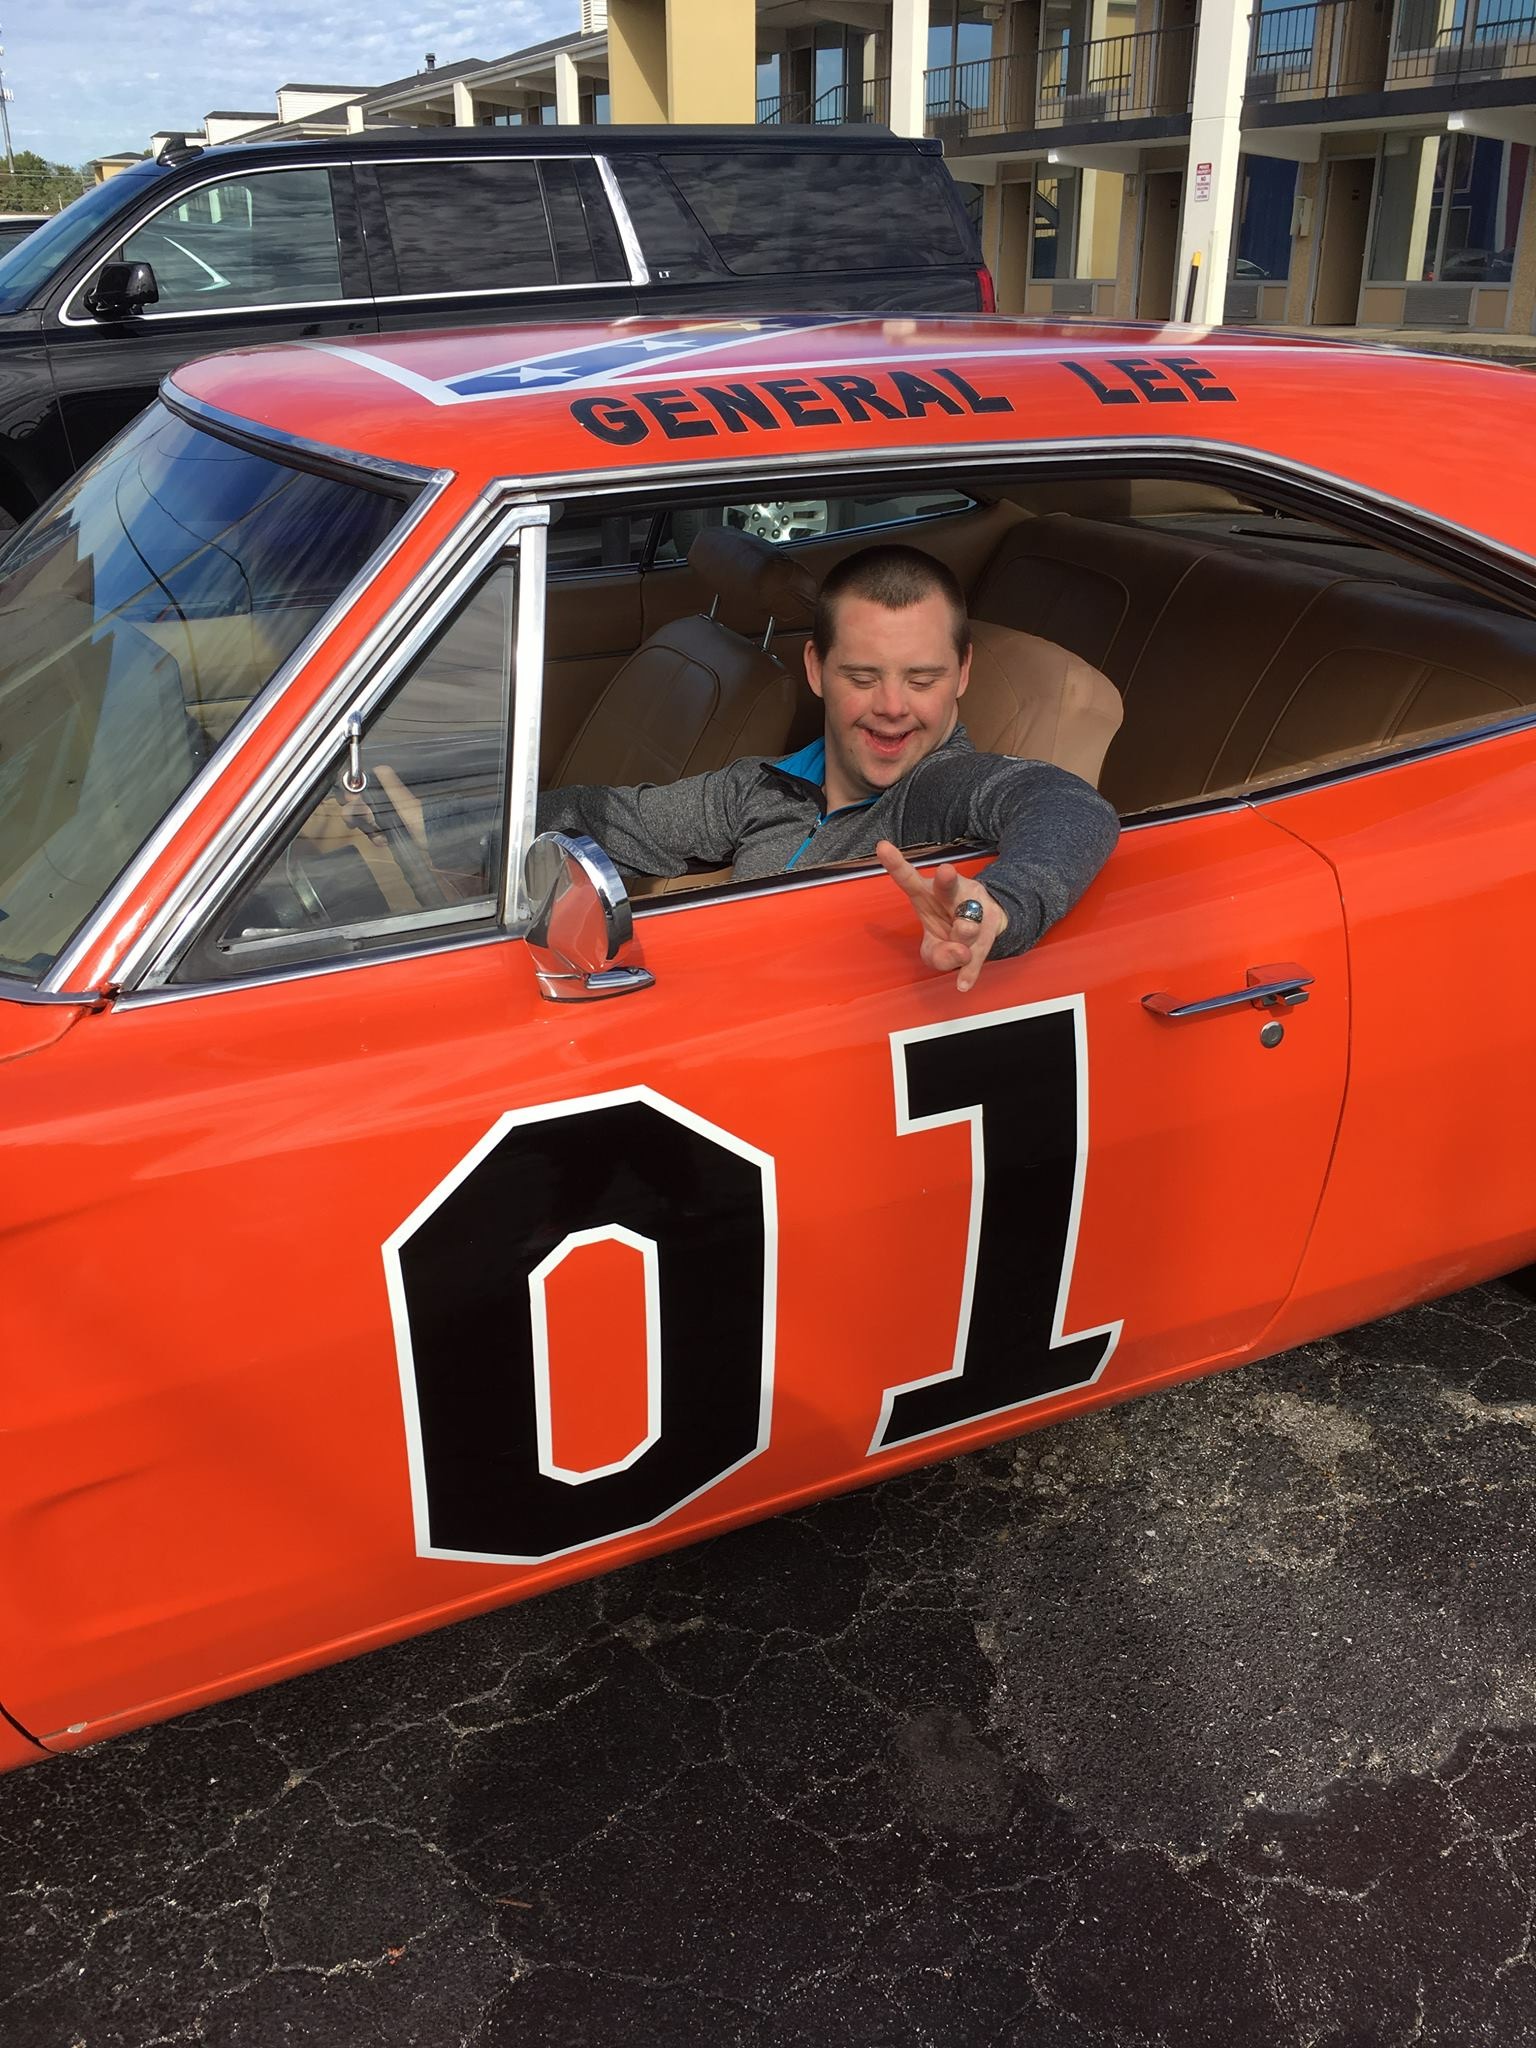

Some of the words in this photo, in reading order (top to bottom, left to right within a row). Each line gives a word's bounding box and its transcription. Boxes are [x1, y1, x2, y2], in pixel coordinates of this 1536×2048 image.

[570, 368, 1014, 446] GENERAL
[1057, 357, 1238, 405] LEE
[381, 993, 1123, 1564] 01
